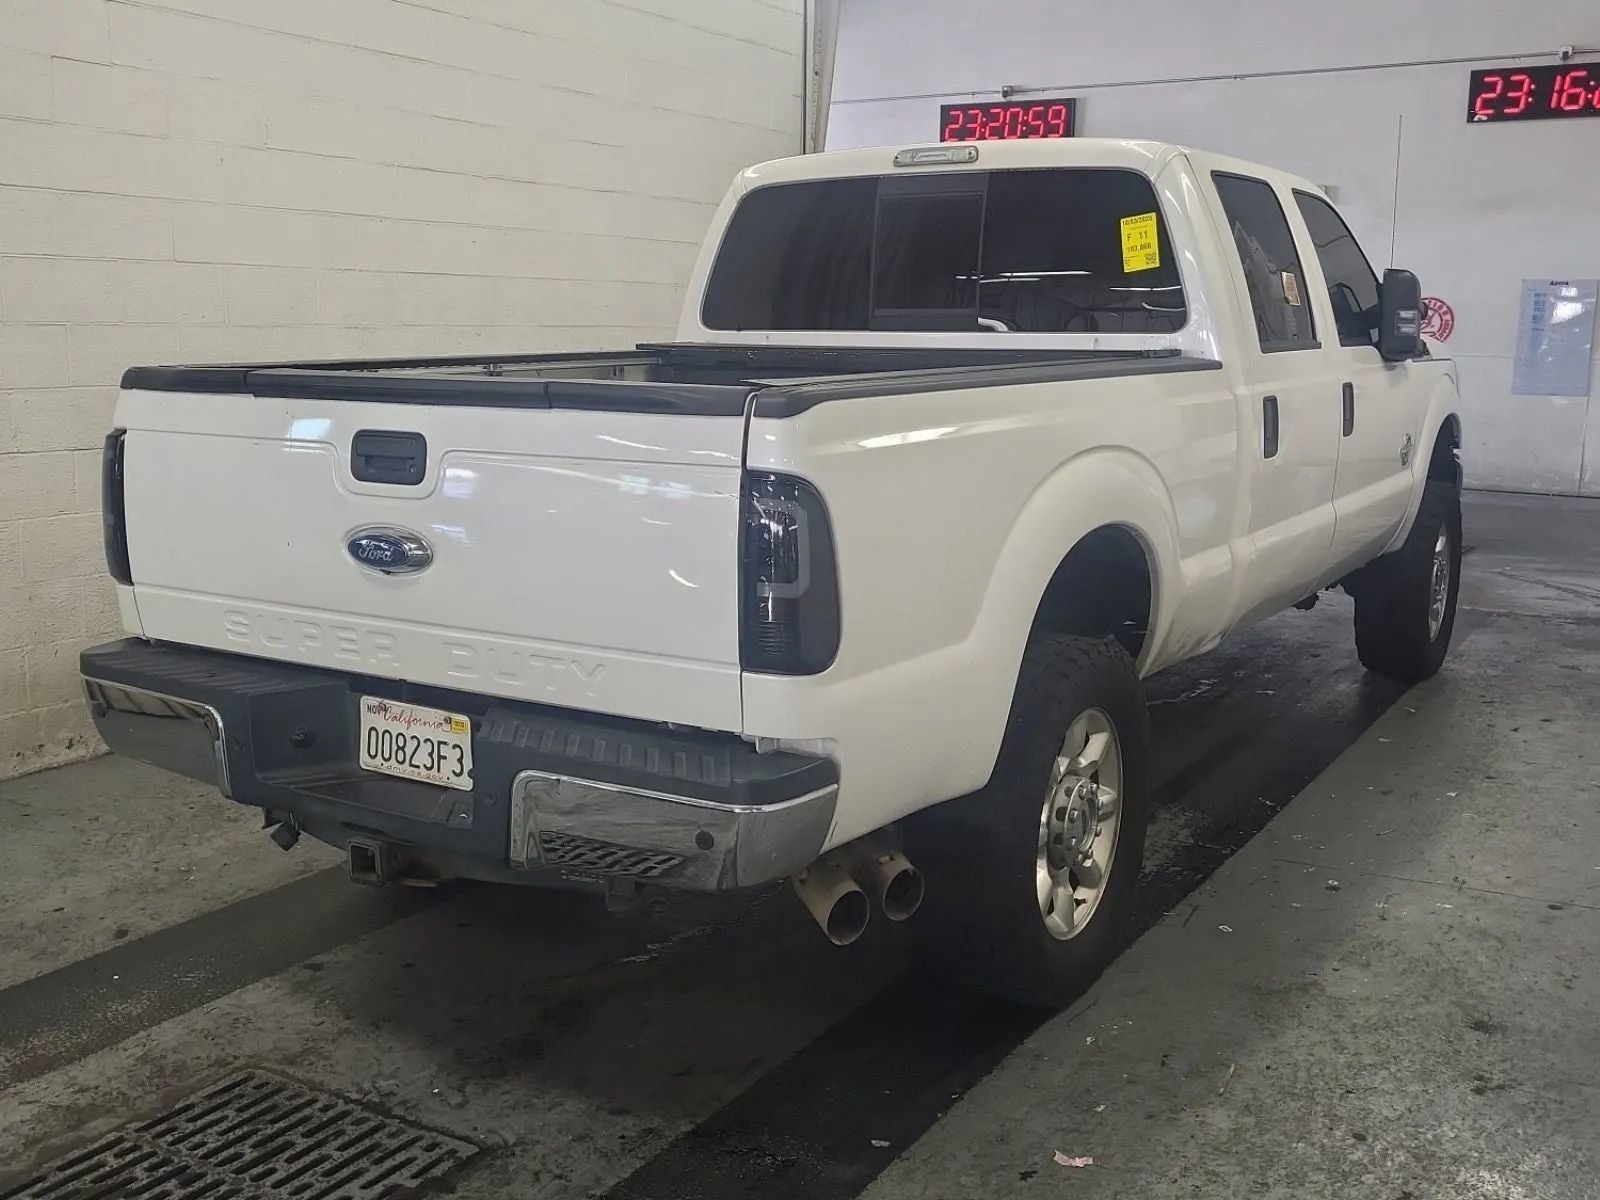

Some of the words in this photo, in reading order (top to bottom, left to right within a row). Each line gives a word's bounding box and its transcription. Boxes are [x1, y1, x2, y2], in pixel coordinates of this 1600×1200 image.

[1475, 70, 1600, 114] 23:16:
[944, 105, 1067, 141] 23:20:59
[359, 540, 394, 561] Ford
[223, 609, 401, 667] SUPER
[441, 640, 607, 697] DUTY
[383, 705, 444, 730] California
[367, 726, 465, 778] 00823F3
